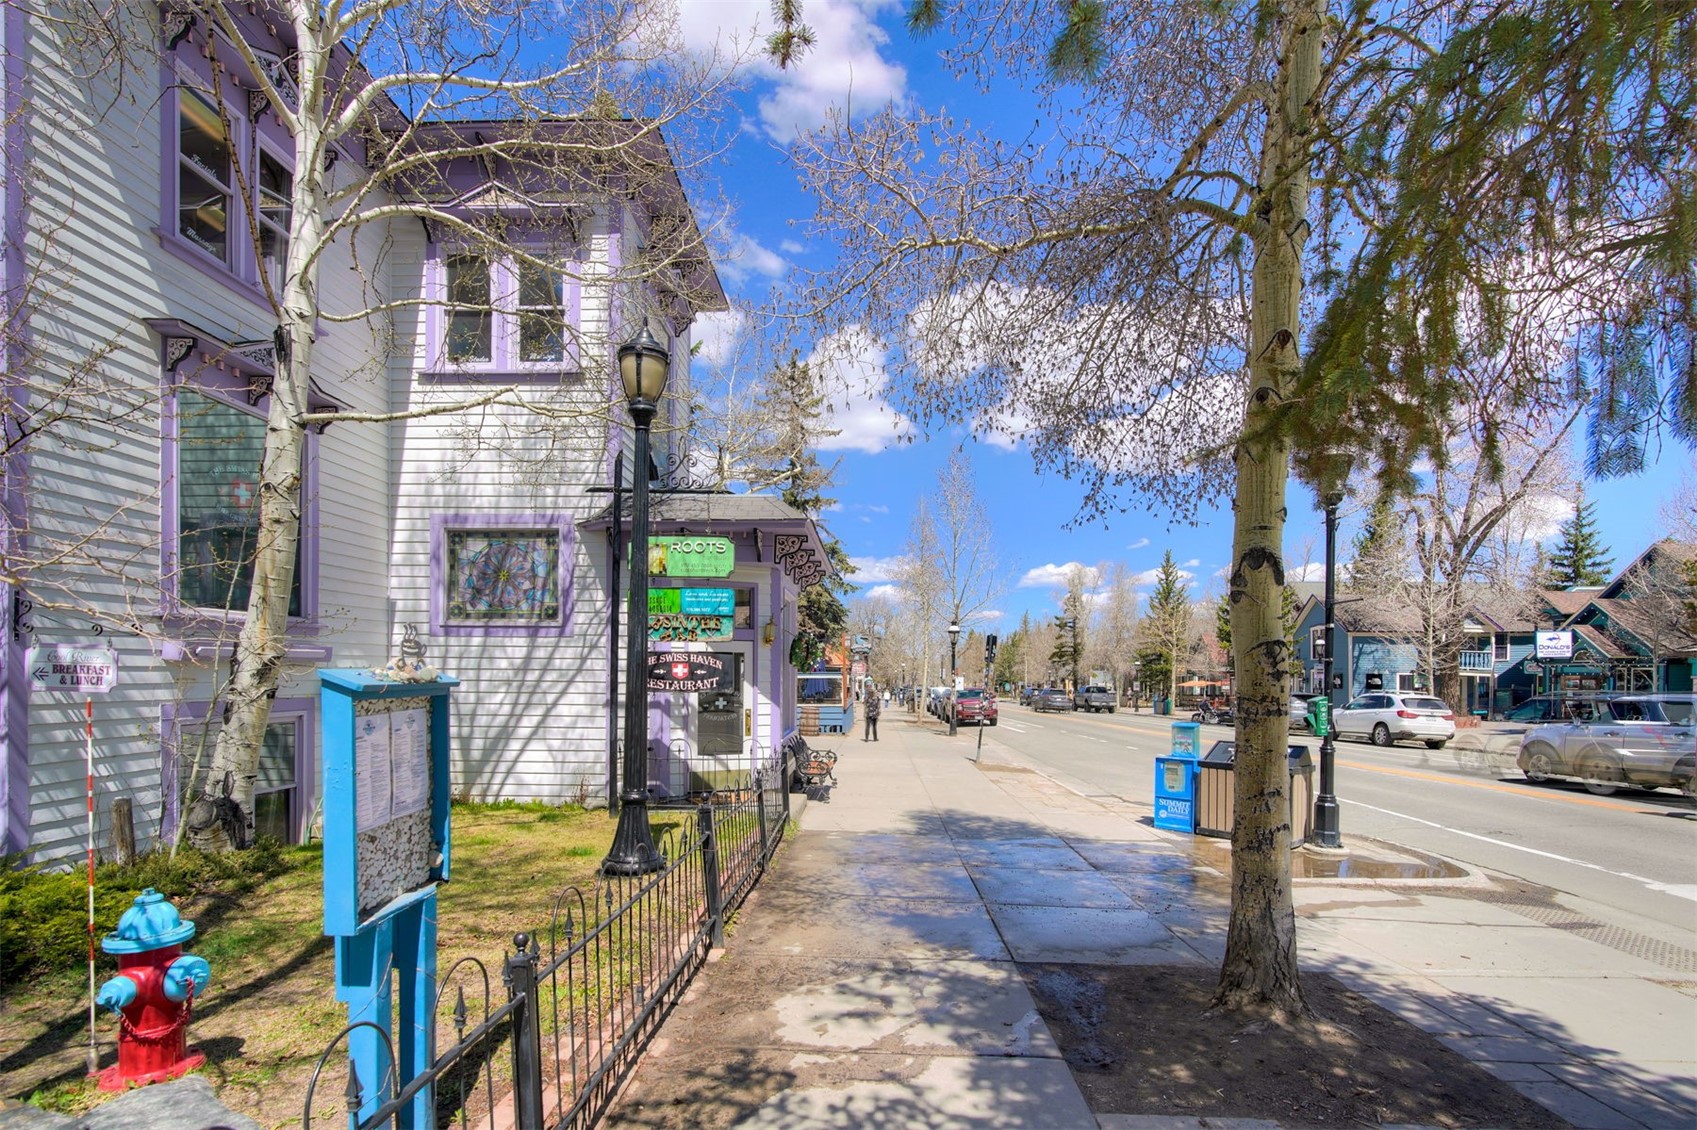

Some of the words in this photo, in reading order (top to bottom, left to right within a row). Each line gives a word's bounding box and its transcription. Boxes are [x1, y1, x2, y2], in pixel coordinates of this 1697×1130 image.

[191, 154, 218, 180] Facials
[187, 226, 217, 253] Massage
[670, 540, 727, 554] ROOTS
[648, 615, 722, 630] BSINTHE
[648, 655, 658, 666] HE
[659, 652, 689, 663] SWISS
[690, 655, 723, 671] HAVEN
[52, 664, 111, 676] BREAKFAST
[60, 675, 67, 685] &
[70, 675, 103, 686] LUNCH
[647, 677, 720, 691] ESTAURANT
[1159, 799, 1191, 810] SUMMIT
[1167, 805, 1190, 815] DAILY
